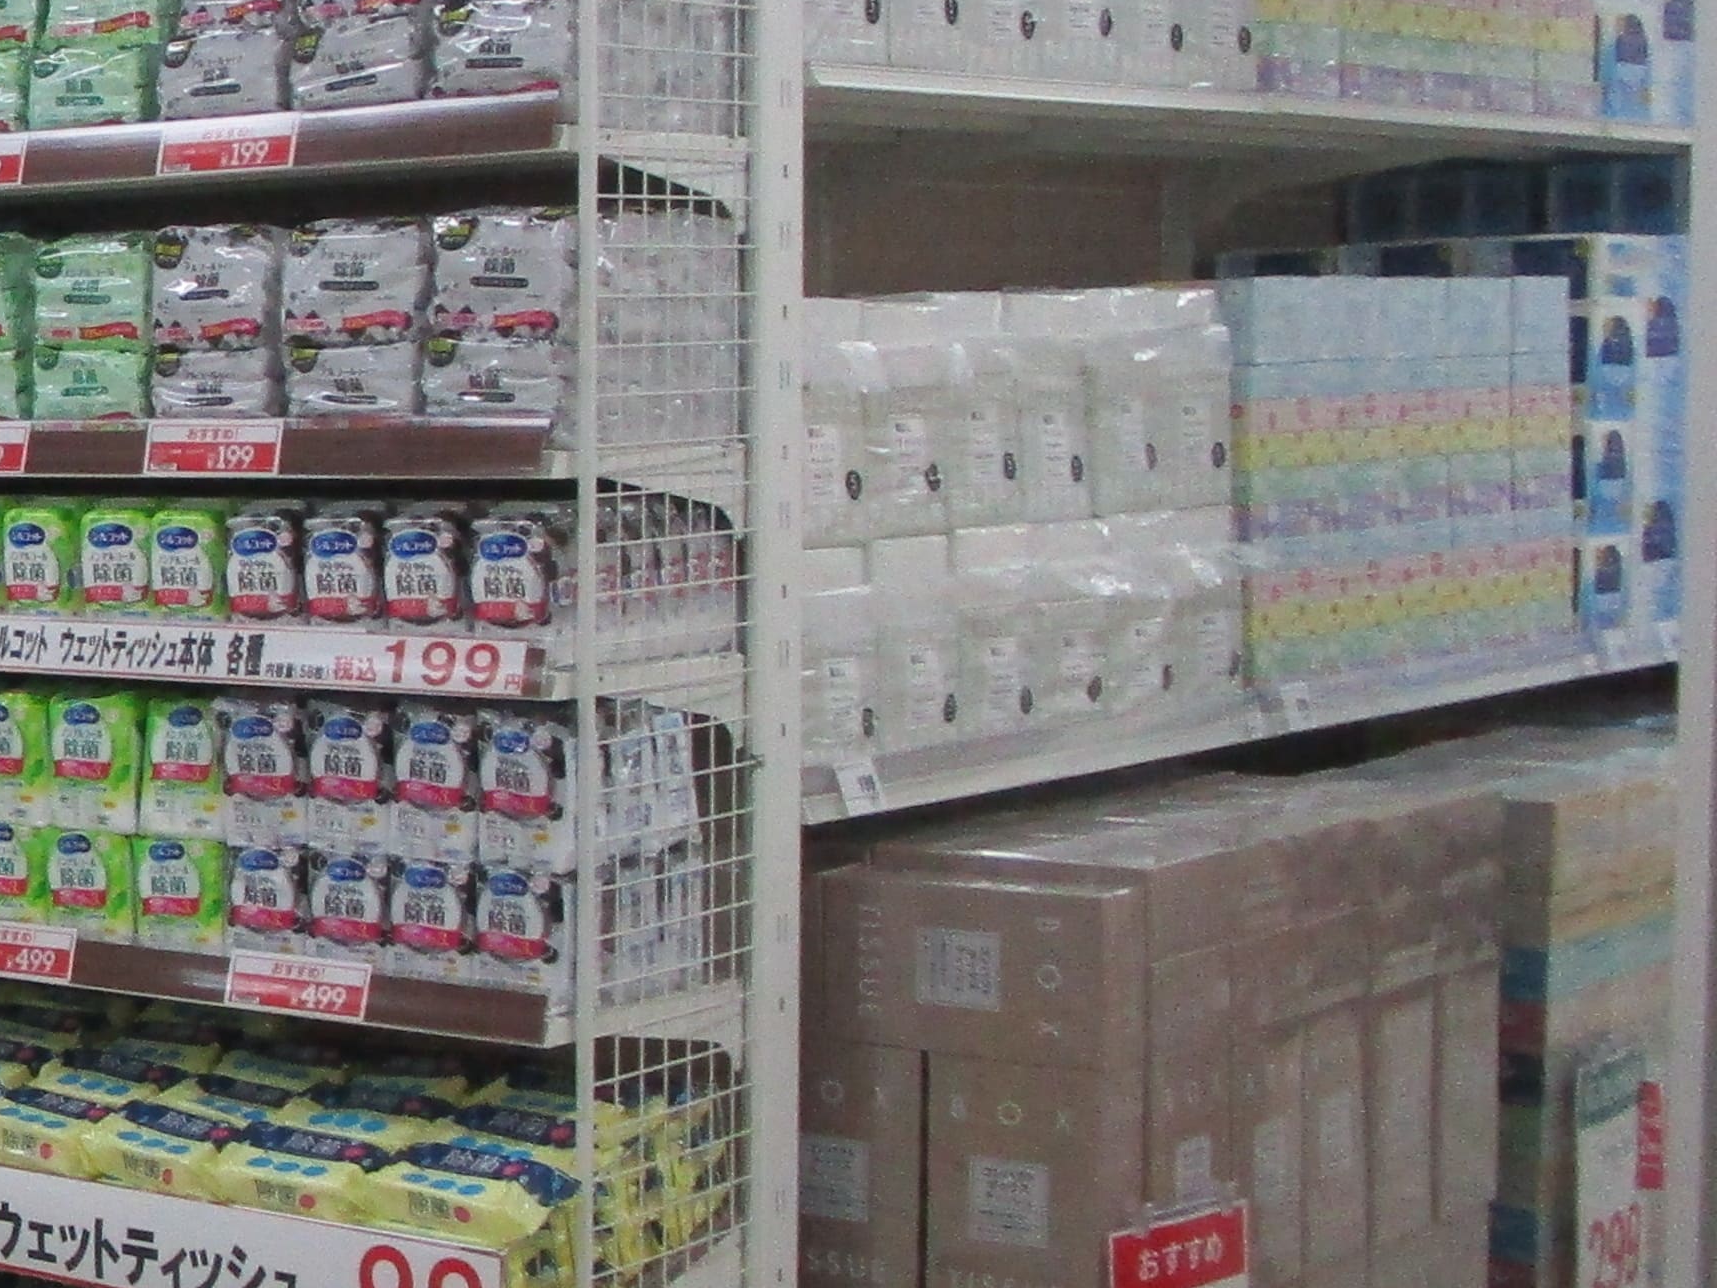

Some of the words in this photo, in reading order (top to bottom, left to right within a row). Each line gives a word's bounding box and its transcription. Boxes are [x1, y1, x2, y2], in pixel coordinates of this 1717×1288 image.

[12, 562, 47, 582] 除菌
[92, 563, 133, 583] 除菌
[160, 567, 199, 586] 除菌
[237, 571, 278, 593] 除菌
[316, 572, 359, 594] 除菌
[395, 573, 438, 596] 除菌
[483, 575, 527, 598] 除菌
[226, 634, 266, 677] 各種
[332, 656, 377, 683] 税込
[385, 639, 503, 690] 199
[504, 676, 529, 692] 円
[1137, 1234, 1224, 1282] おすすめ
